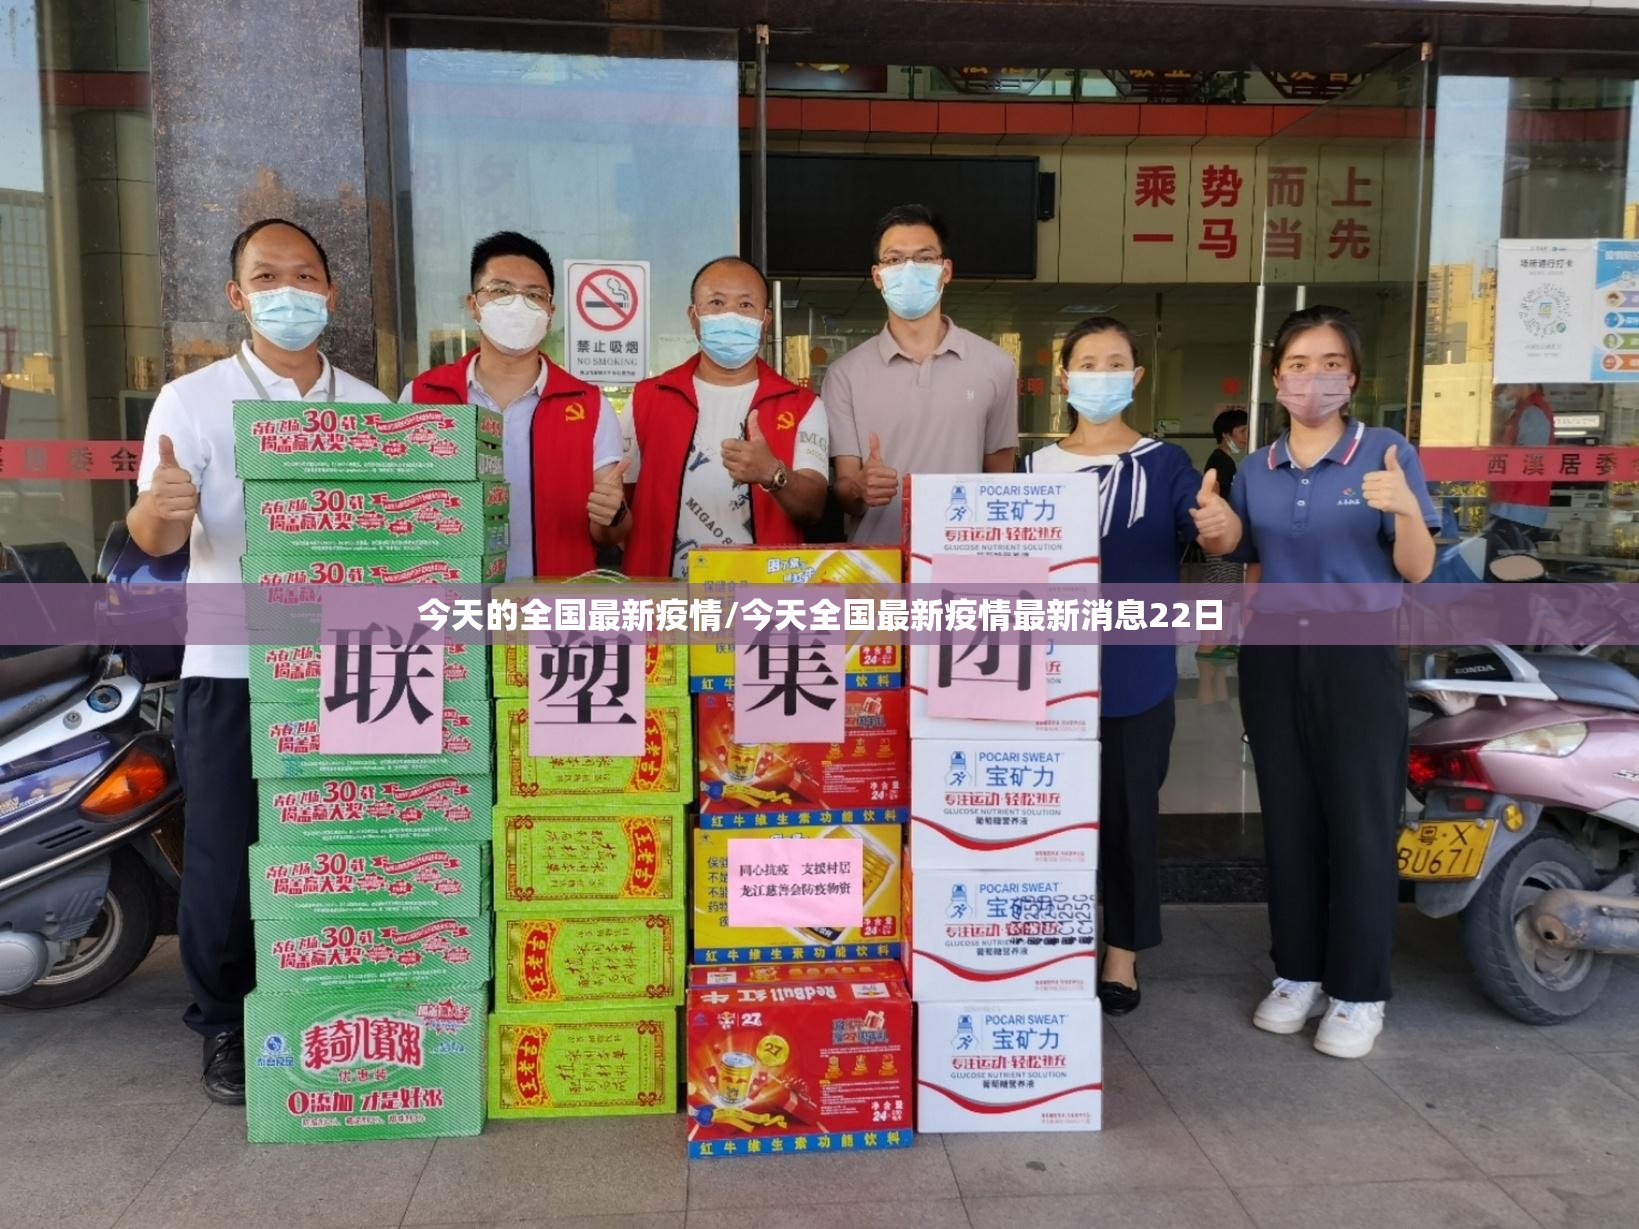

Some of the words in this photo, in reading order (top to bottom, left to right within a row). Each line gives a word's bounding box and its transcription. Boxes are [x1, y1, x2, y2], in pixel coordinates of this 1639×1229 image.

[1134, 164, 1372, 208] 乘势而上
[1132, 217, 1371, 260] 一马当先
[577, 340, 639, 354] 禁止吸烟
[577, 358, 591, 366] NO
[593, 358, 638, 366] SMOKING
[980, 486, 1021, 496] POCARI
[1023, 485, 1062, 496] SWEAT
[986, 499, 1056, 522] 宝矿力
[324, 621, 435, 725] 联
[534, 629, 638, 725] 塑
[742, 617, 840, 716] 集
[938, 588, 1037, 692] 团
[979, 752, 1020, 762] POCARI
[1021, 752, 1061, 763] SWEAT
[986, 765, 1055, 788] 宝矿力
[981, 808, 1020, 816] NUTRIENT
[1021, 808, 1061, 816] SOLUTION
[634, 832, 655, 883] 王老吉
[739, 863, 790, 877] 同心抗疫
[801, 861, 851, 875] 支援村居
[739, 881, 852, 898] 龙江慈善会防疫物资
[979, 884, 1020, 894] POCARI
[1021, 882, 1059, 893] SWEAT
[526, 935, 546, 986] 王老吉
[769, 983, 837, 999] RedBull
[741, 1012, 763, 1026] 27
[985, 1014, 1025, 1025] POCARI
[1027, 1014, 1065, 1025] SWEAT
[304, 1016, 422, 1070] 泰奇八寶粥
[992, 1028, 1059, 1050] 宝矿力
[517, 1040, 539, 1093] 王老吉
[338, 1067, 388, 1083] 优惠装
[360, 1086, 444, 1112] 才是好粥
[872, 1110, 887, 1122] 24
